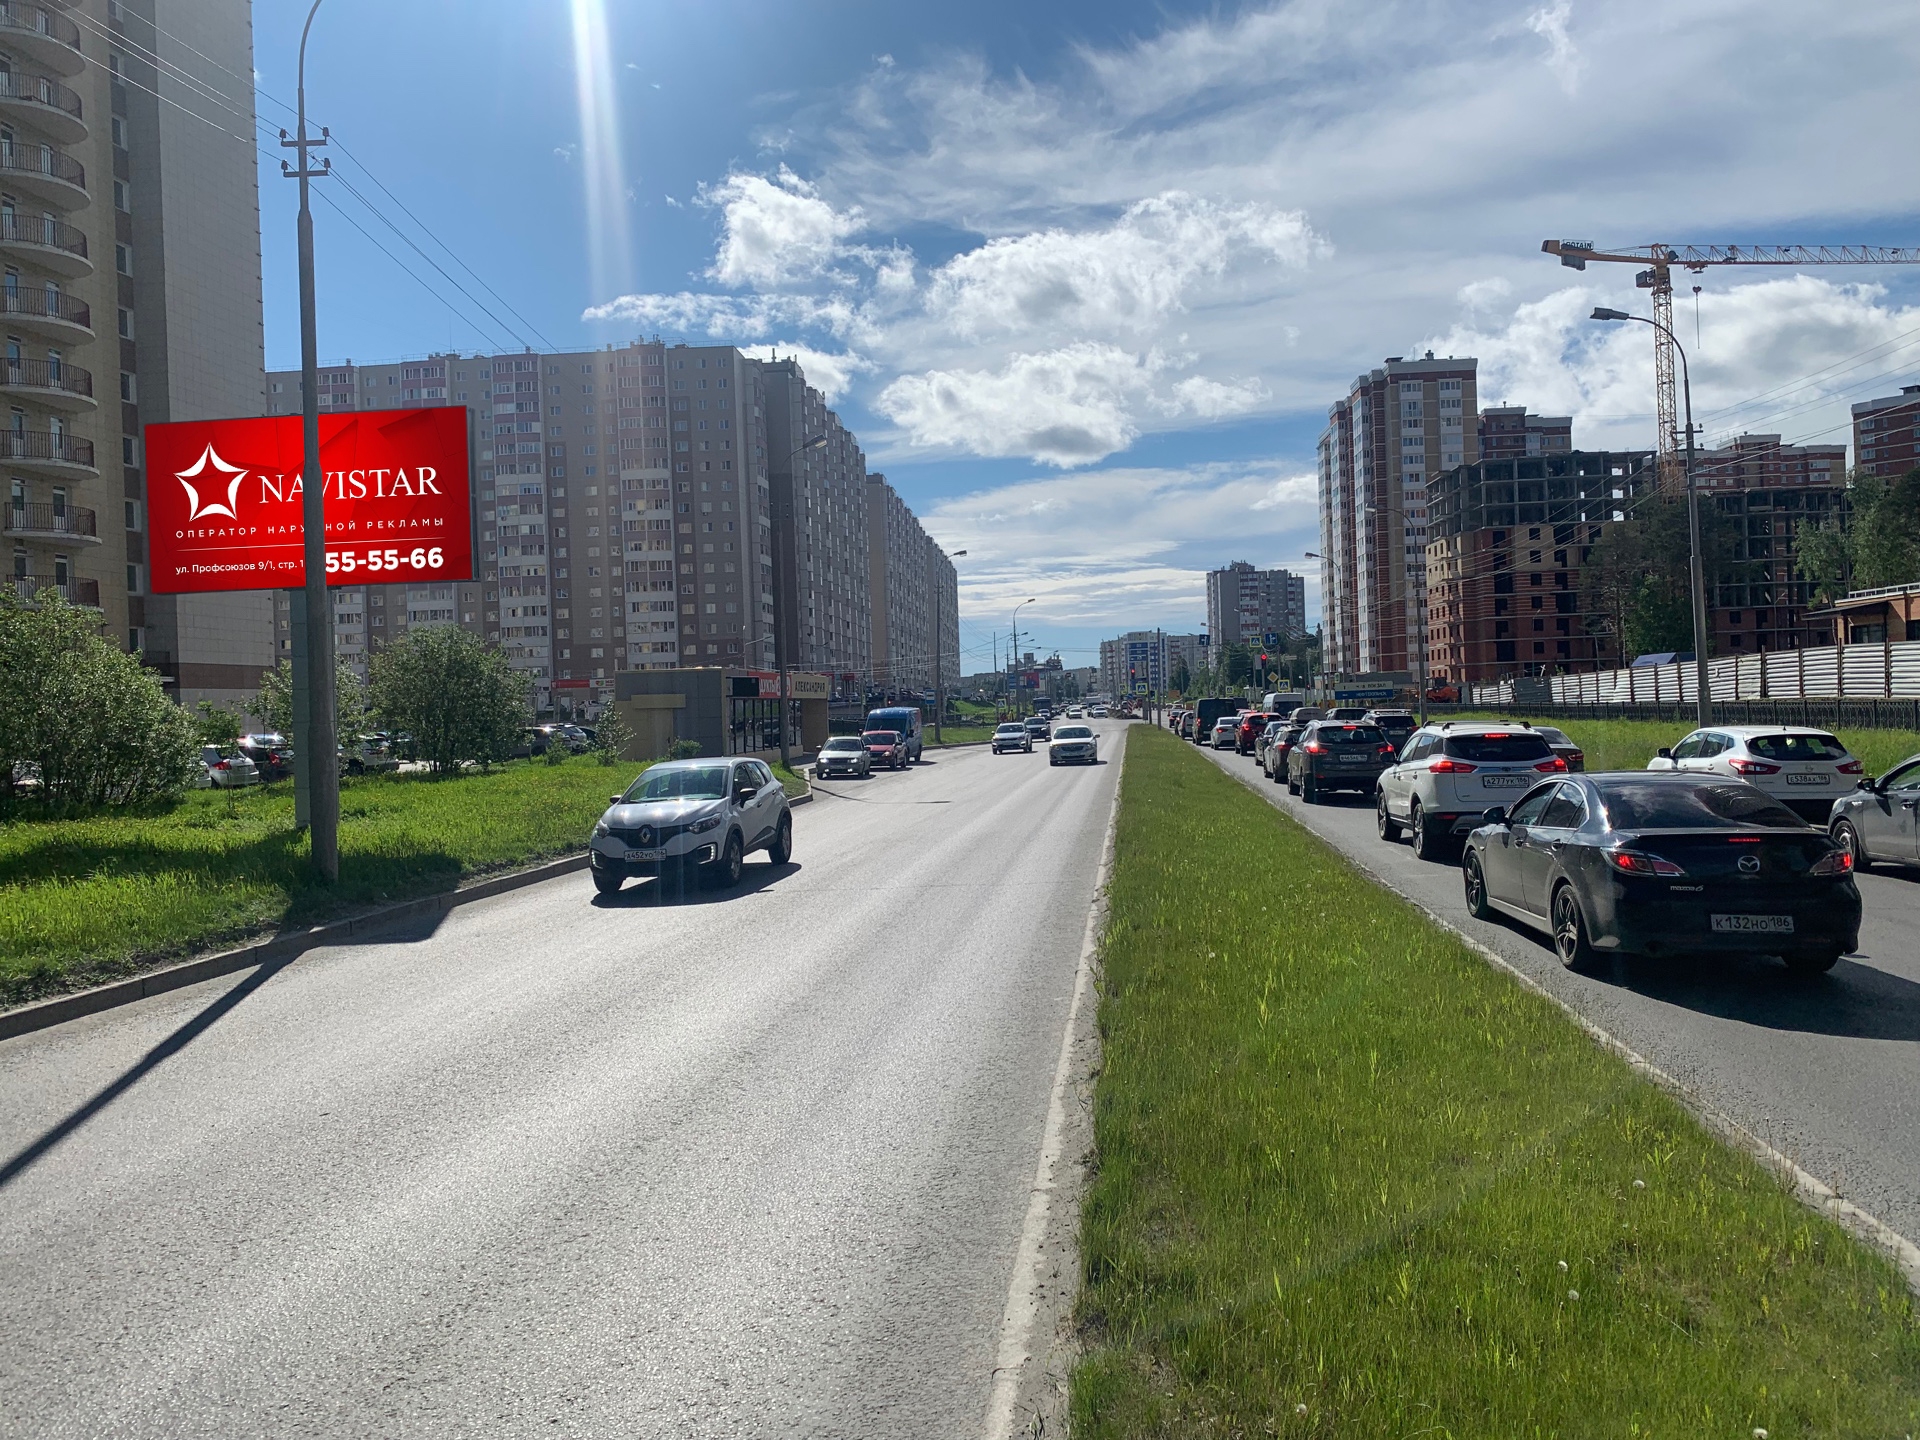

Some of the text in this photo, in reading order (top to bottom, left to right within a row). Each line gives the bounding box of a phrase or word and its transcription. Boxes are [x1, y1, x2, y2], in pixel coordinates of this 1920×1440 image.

[176, 518, 443, 538] ОПЕРАТОР НАРУНОЙ РЕКЛАМЫ
[176, 566, 189, 575] ул.
[192, 562, 256, 573] Профсоюзов
[258, 560, 275, 571] 9/1,
[325, 547, 445, 573] 55-55-66
[795, 681, 826, 693] АЛЕКСАНДРИЯ
[1716, 916, 1790, 930] К132НО 186
